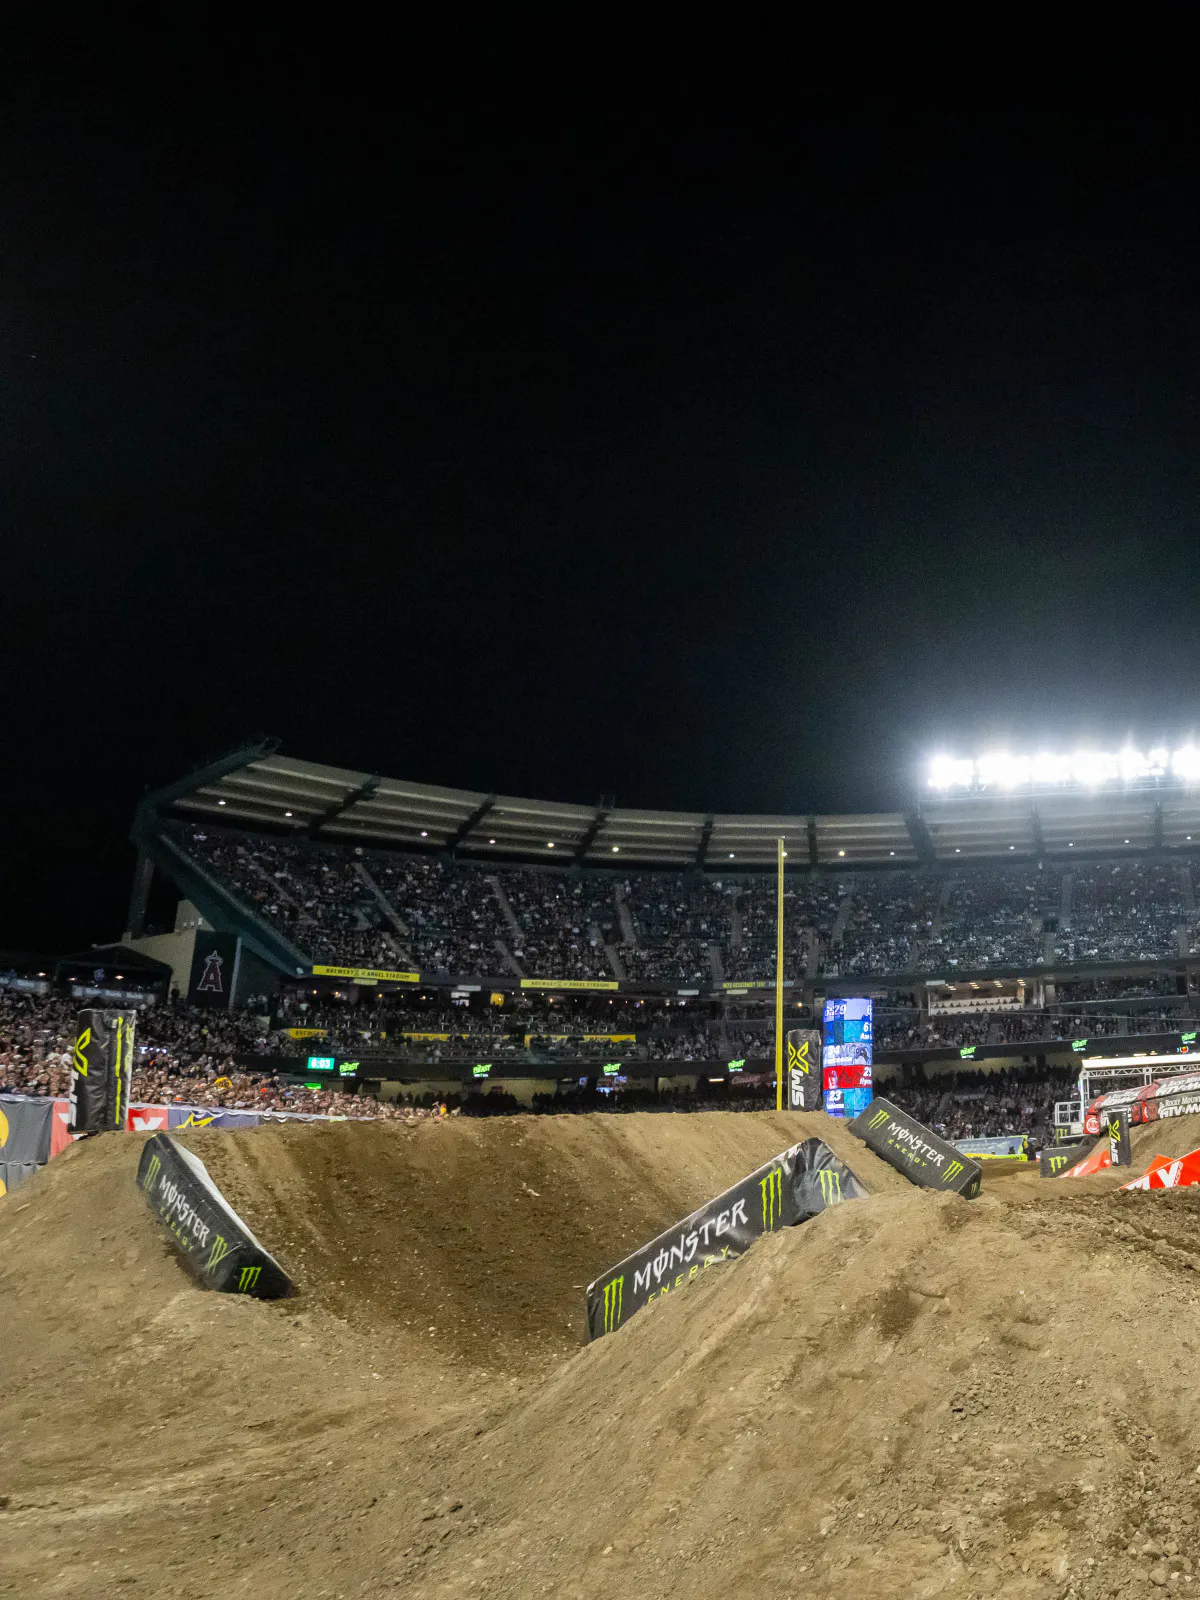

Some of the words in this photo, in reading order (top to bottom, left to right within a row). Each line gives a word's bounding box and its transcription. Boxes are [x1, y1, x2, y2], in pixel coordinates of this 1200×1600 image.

[788, 1041, 809, 1108] SMX
[887, 1122, 945, 1167] MONSTER
[888, 1139, 928, 1167] ENERGY
[159, 1174, 211, 1248] MONSTER
[632, 1198, 749, 1295] MONSTER
[647, 1244, 730, 1304] ENERGY
